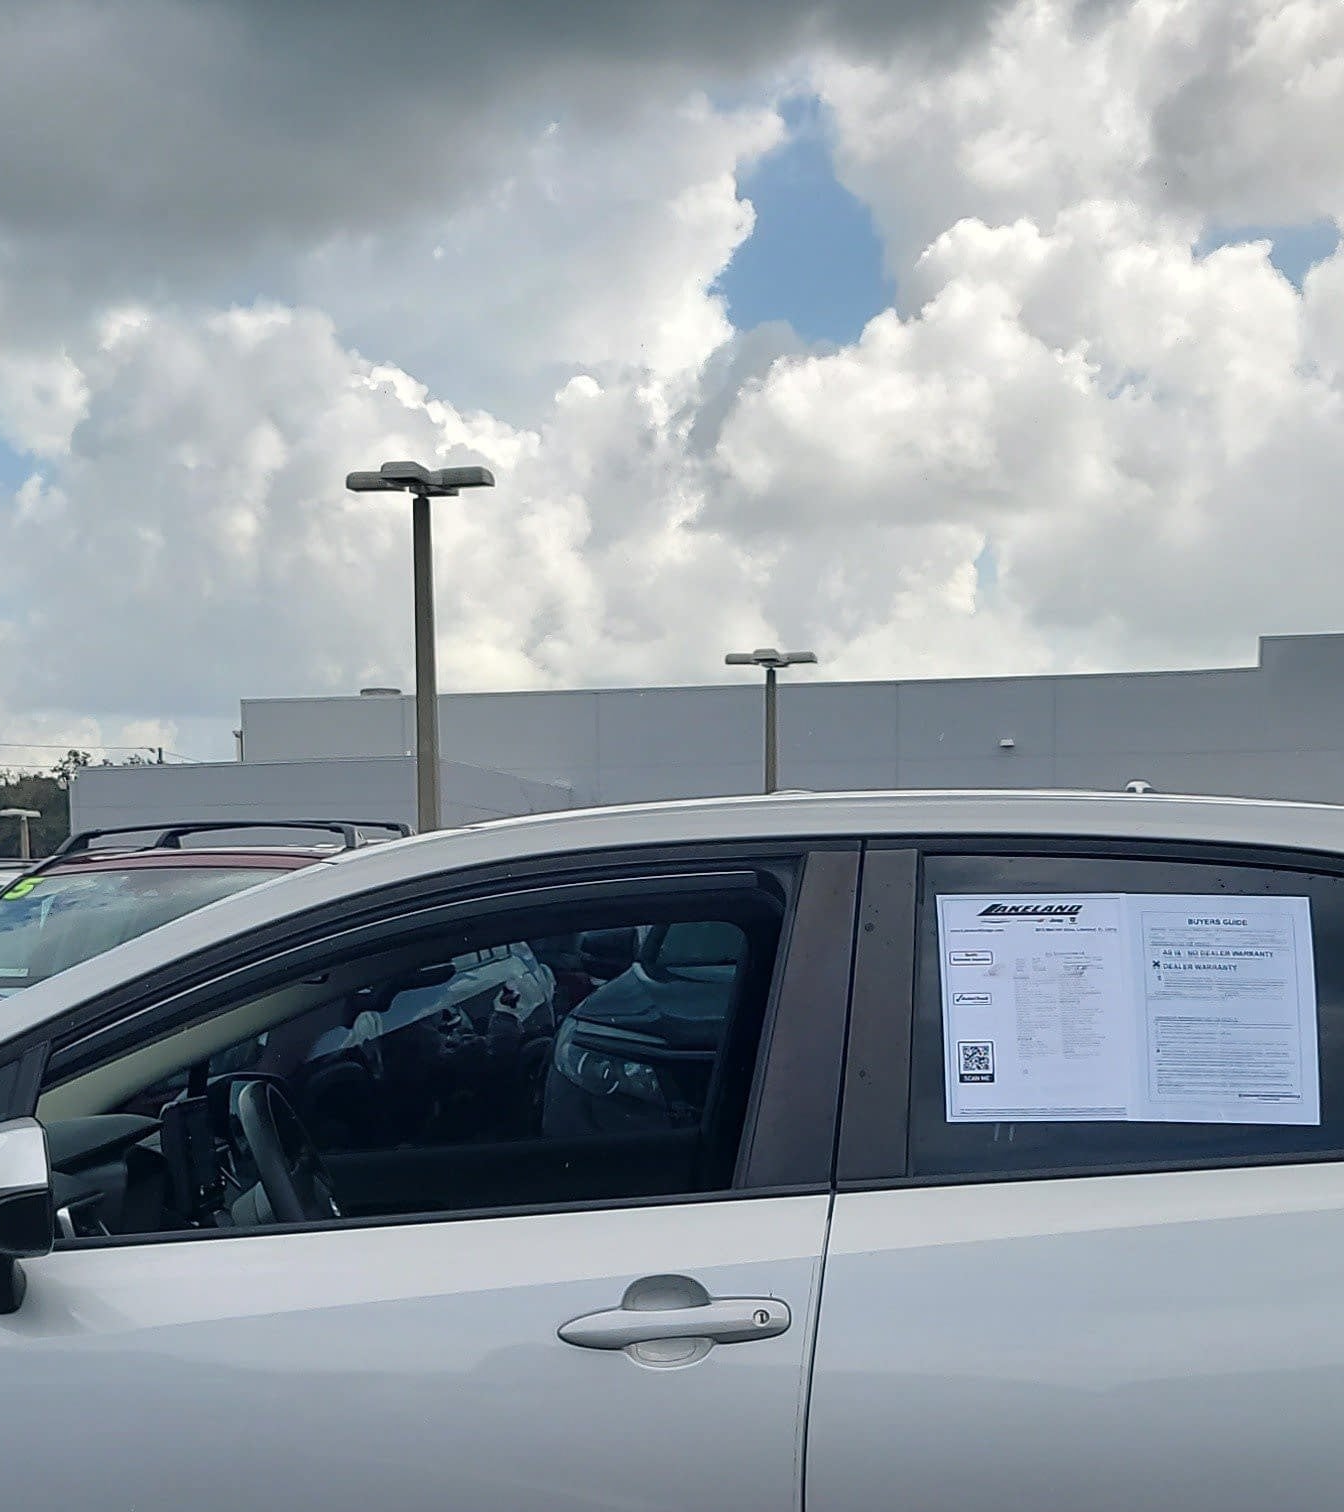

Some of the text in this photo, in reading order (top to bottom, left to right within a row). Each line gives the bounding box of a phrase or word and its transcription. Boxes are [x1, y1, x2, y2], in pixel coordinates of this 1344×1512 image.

[977, 903, 1083, 916] LAKELAND
[1187, 918, 1248, 926] BUYERS GUIDE
[1232, 950, 1274, 958] WARRANTY
[1195, 963, 1237, 971] WARRANTY
